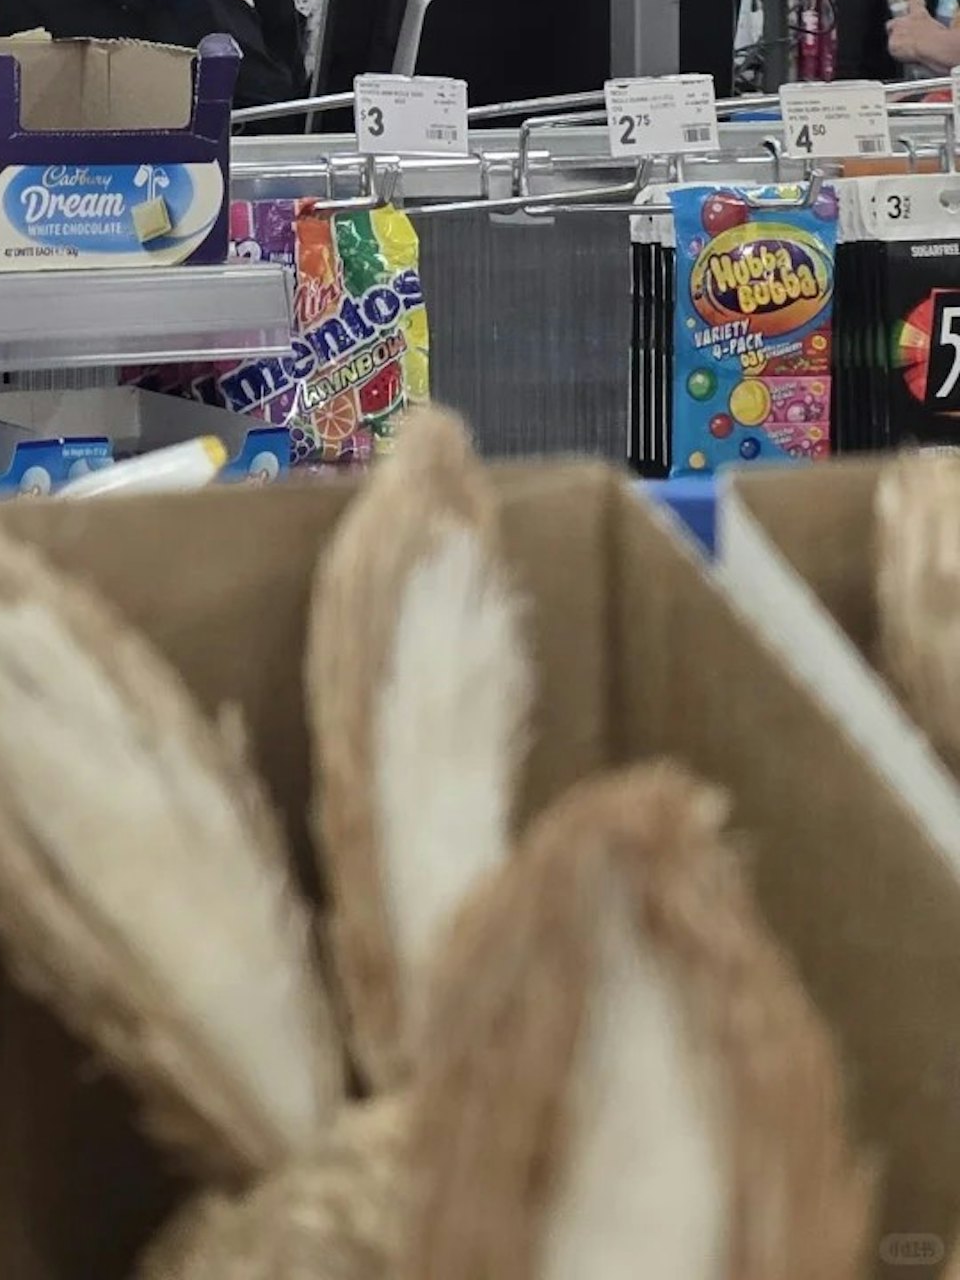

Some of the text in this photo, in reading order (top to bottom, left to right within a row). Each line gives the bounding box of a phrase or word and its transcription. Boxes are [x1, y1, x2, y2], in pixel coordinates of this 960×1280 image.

[42, 164, 113, 191] Cadbury
[21, 186, 125, 223] Dream
[887, 195, 902, 219] 3
[27, 221, 122, 236] WHITE CHOCOLATE
[709, 245, 792, 294] Hubba
[737, 264, 819, 314] Bubba
[221, 269, 425, 412] mentos
[694, 317, 751, 348] VARIETY
[302, 331, 408, 410] RAINBOW
